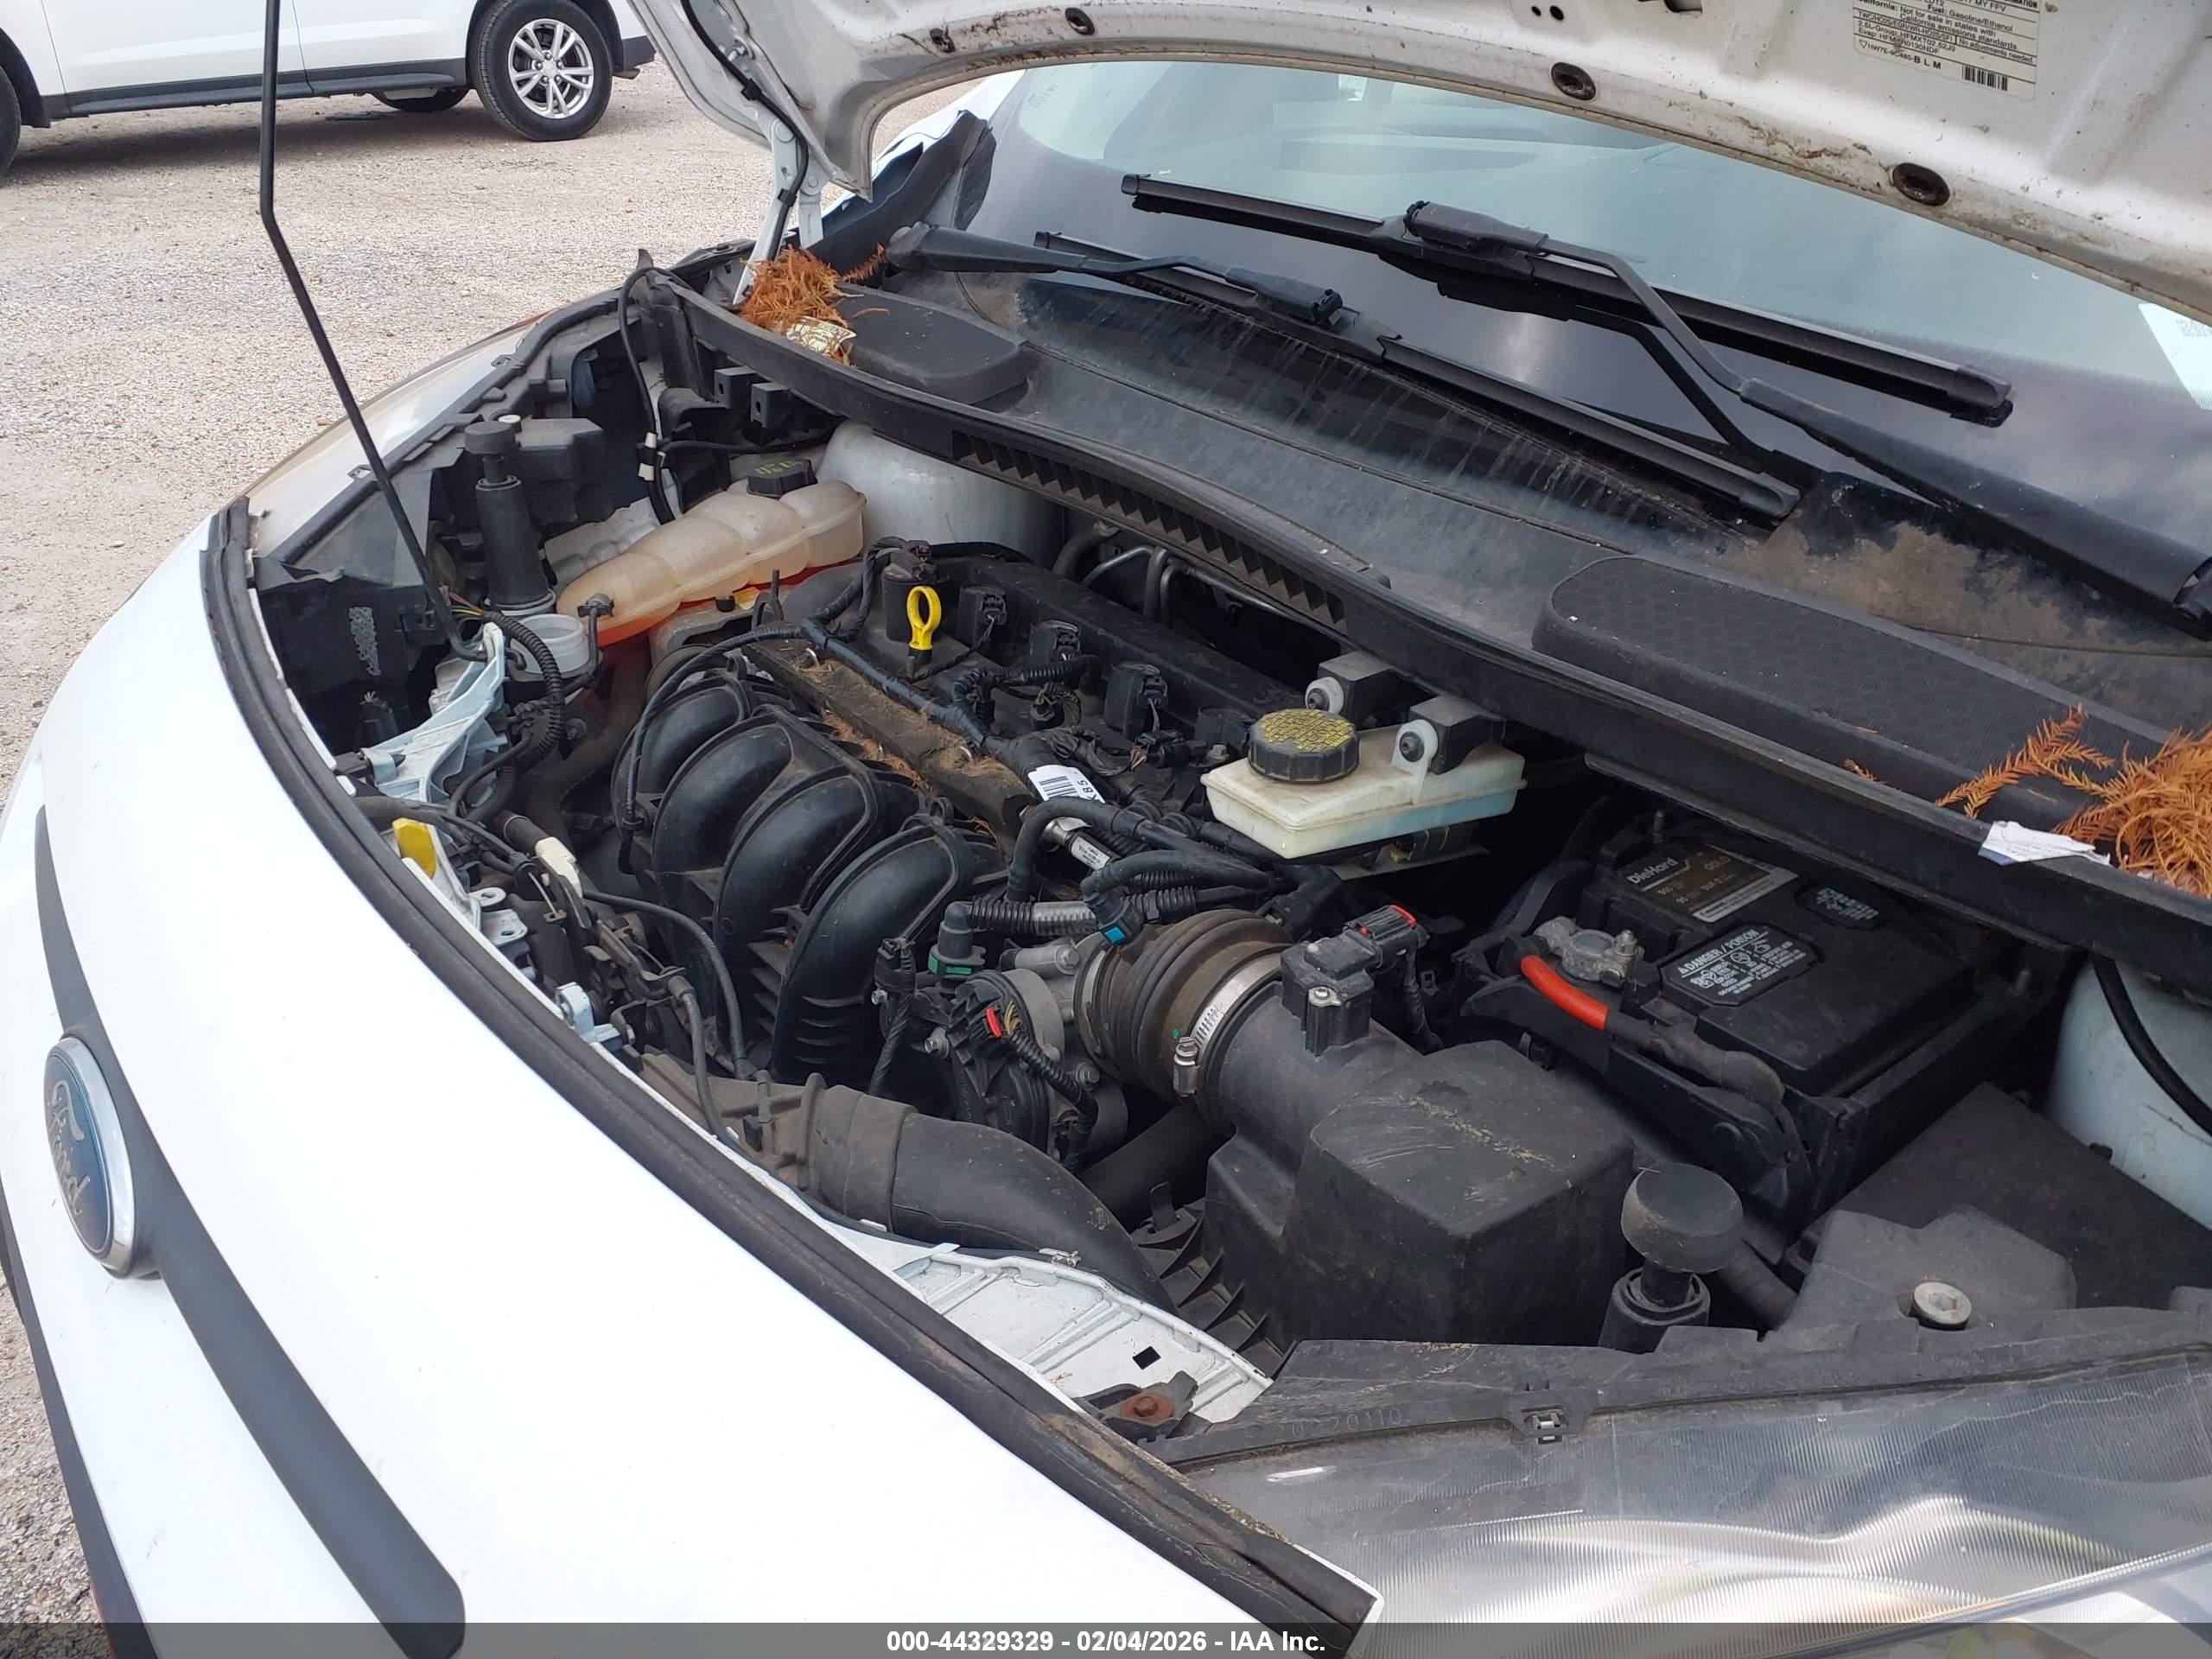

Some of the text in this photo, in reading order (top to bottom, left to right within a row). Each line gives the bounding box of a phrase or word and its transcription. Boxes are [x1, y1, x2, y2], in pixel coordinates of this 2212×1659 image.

[1900, 6, 1913, 15] Not
[1928, 14, 1943, 22] sale
[1955, 22, 1978, 33] states
[1980, 28, 1996, 37] with
[1901, 13, 1936, 29] California
[1937, 24, 1976, 40] emissions
[1949, 10, 2013, 31] Gasoline/Ethanol
[1969, 41, 2008, 57] adjustments
[1626, 856, 1679, 885] DieHard
[1683, 948, 1724, 971] DANGER
[1724, 929, 1761, 950] POISON
[48, 1079, 85, 1213] Ford
